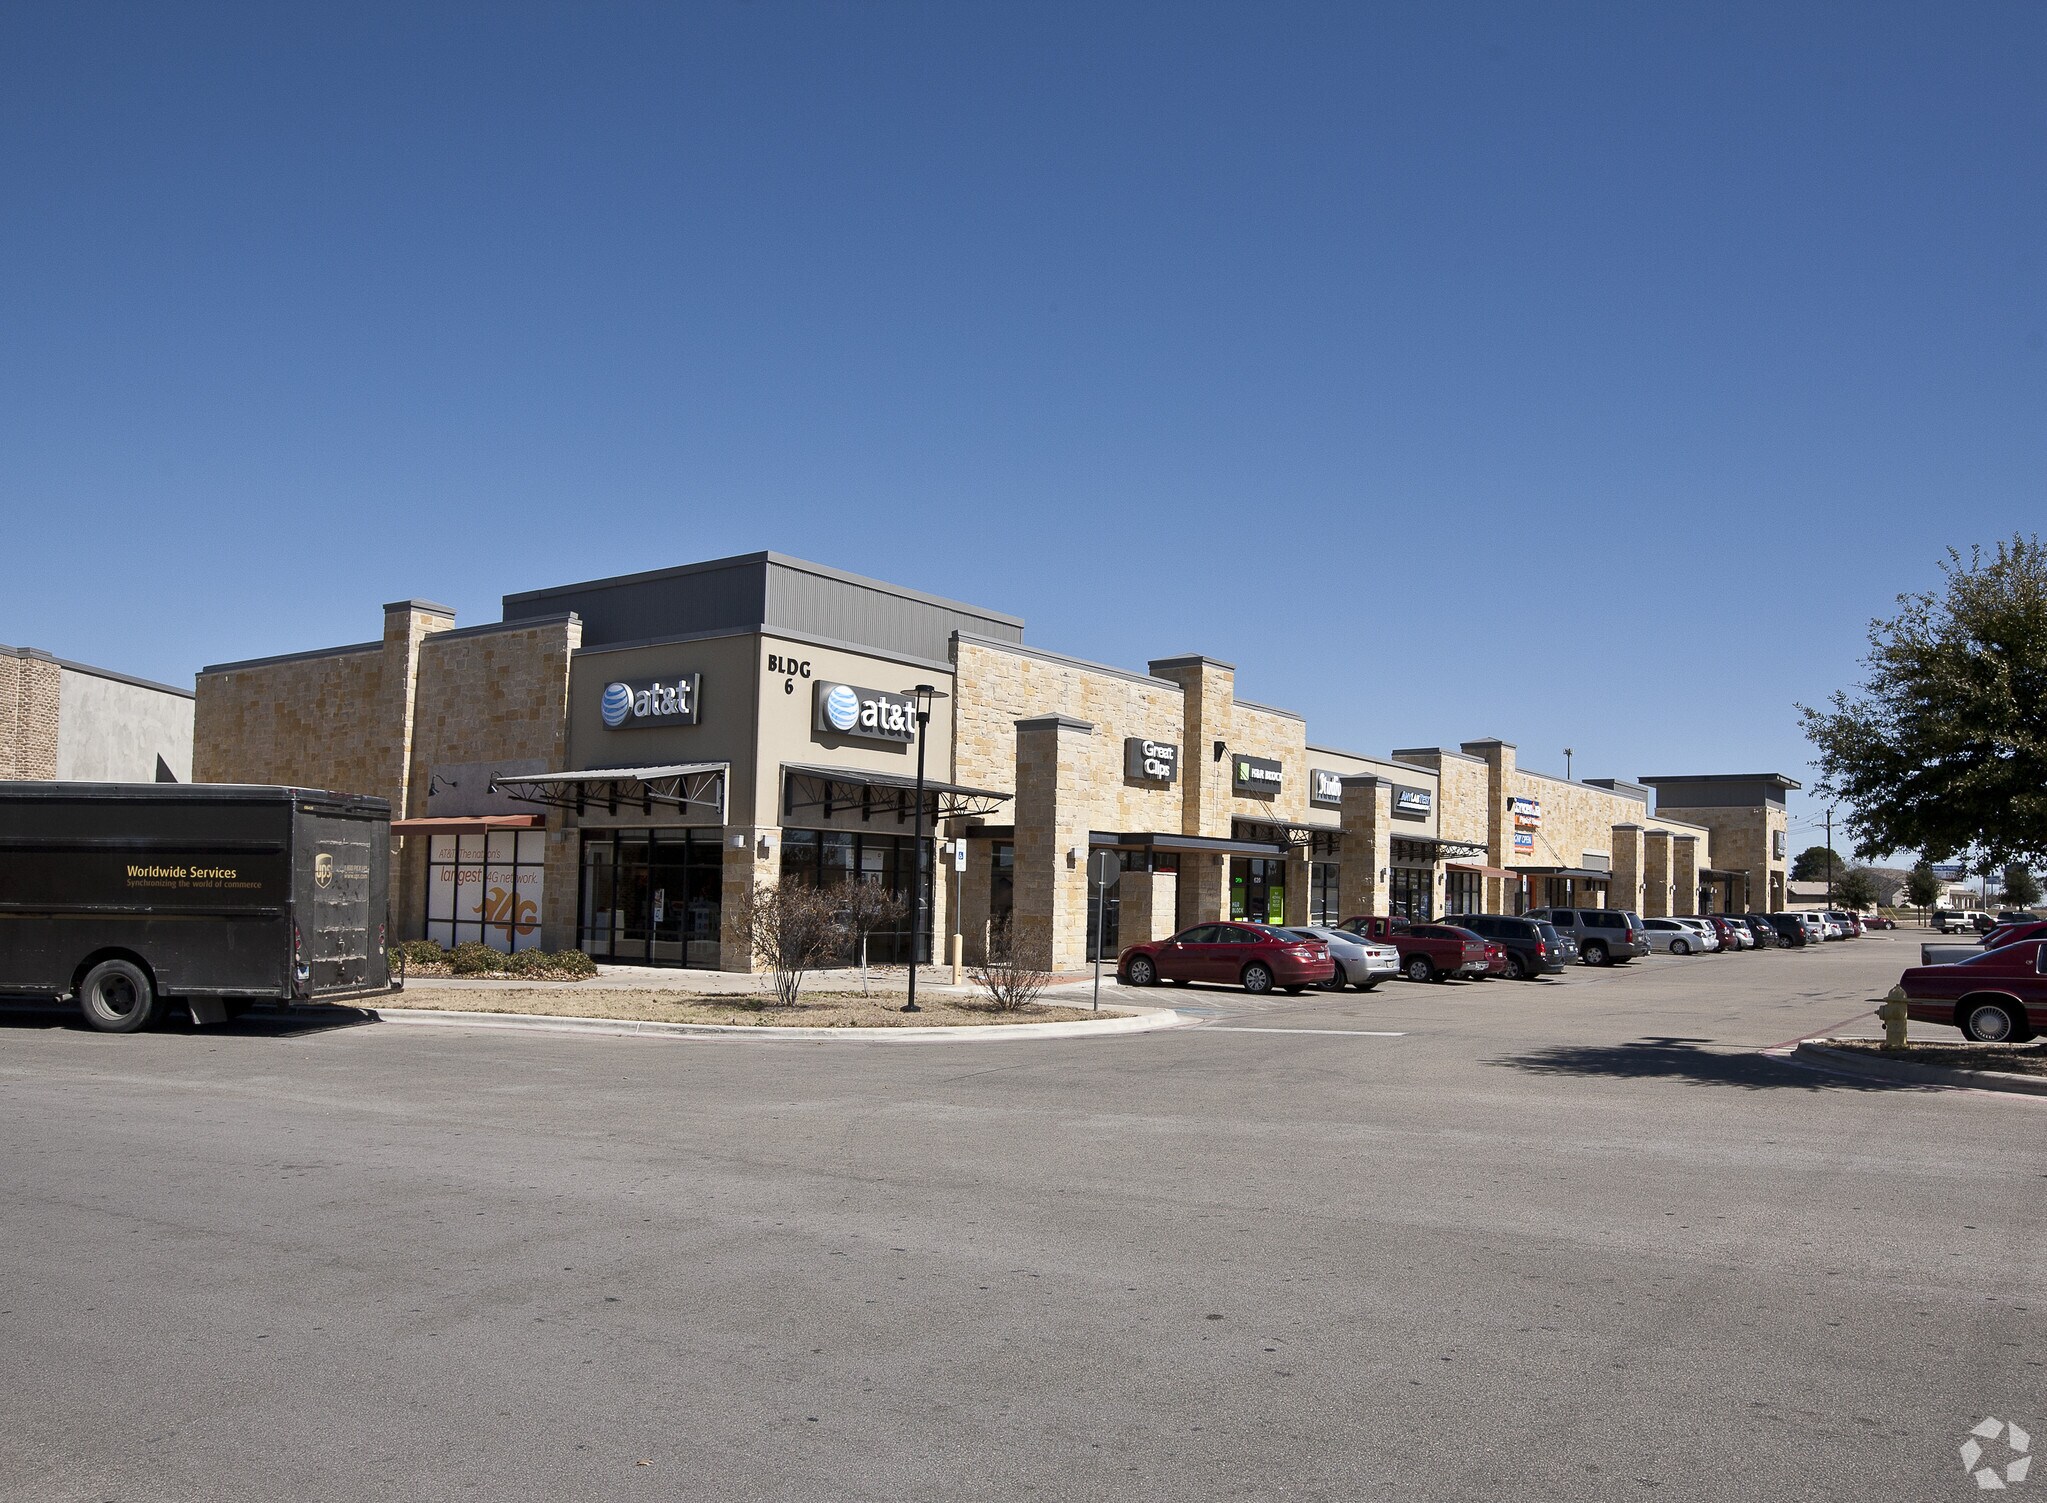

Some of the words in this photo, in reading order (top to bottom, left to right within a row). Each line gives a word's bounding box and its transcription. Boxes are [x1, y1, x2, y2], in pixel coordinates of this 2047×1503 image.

[767, 654, 811, 678] BLDG
[784, 678, 794, 695] 6
[634, 679, 691, 717] at&t
[860, 696, 916, 734] at&t
[1142, 740, 1174, 760] Great
[1144, 758, 1170, 780] Clips
[460, 848, 472, 859] The
[472, 848, 501, 859] naon's
[127, 865, 187, 878] Worldwide
[190, 866, 237, 879] Services
[317, 864, 331, 884] ups
[440, 866, 482, 886] largest
[487, 871, 499, 883] 4G
[127, 879, 177, 889] Synchronizing
[178, 880, 191, 888] the
[192, 880, 213, 888] world
[214, 880, 222, 889] of
